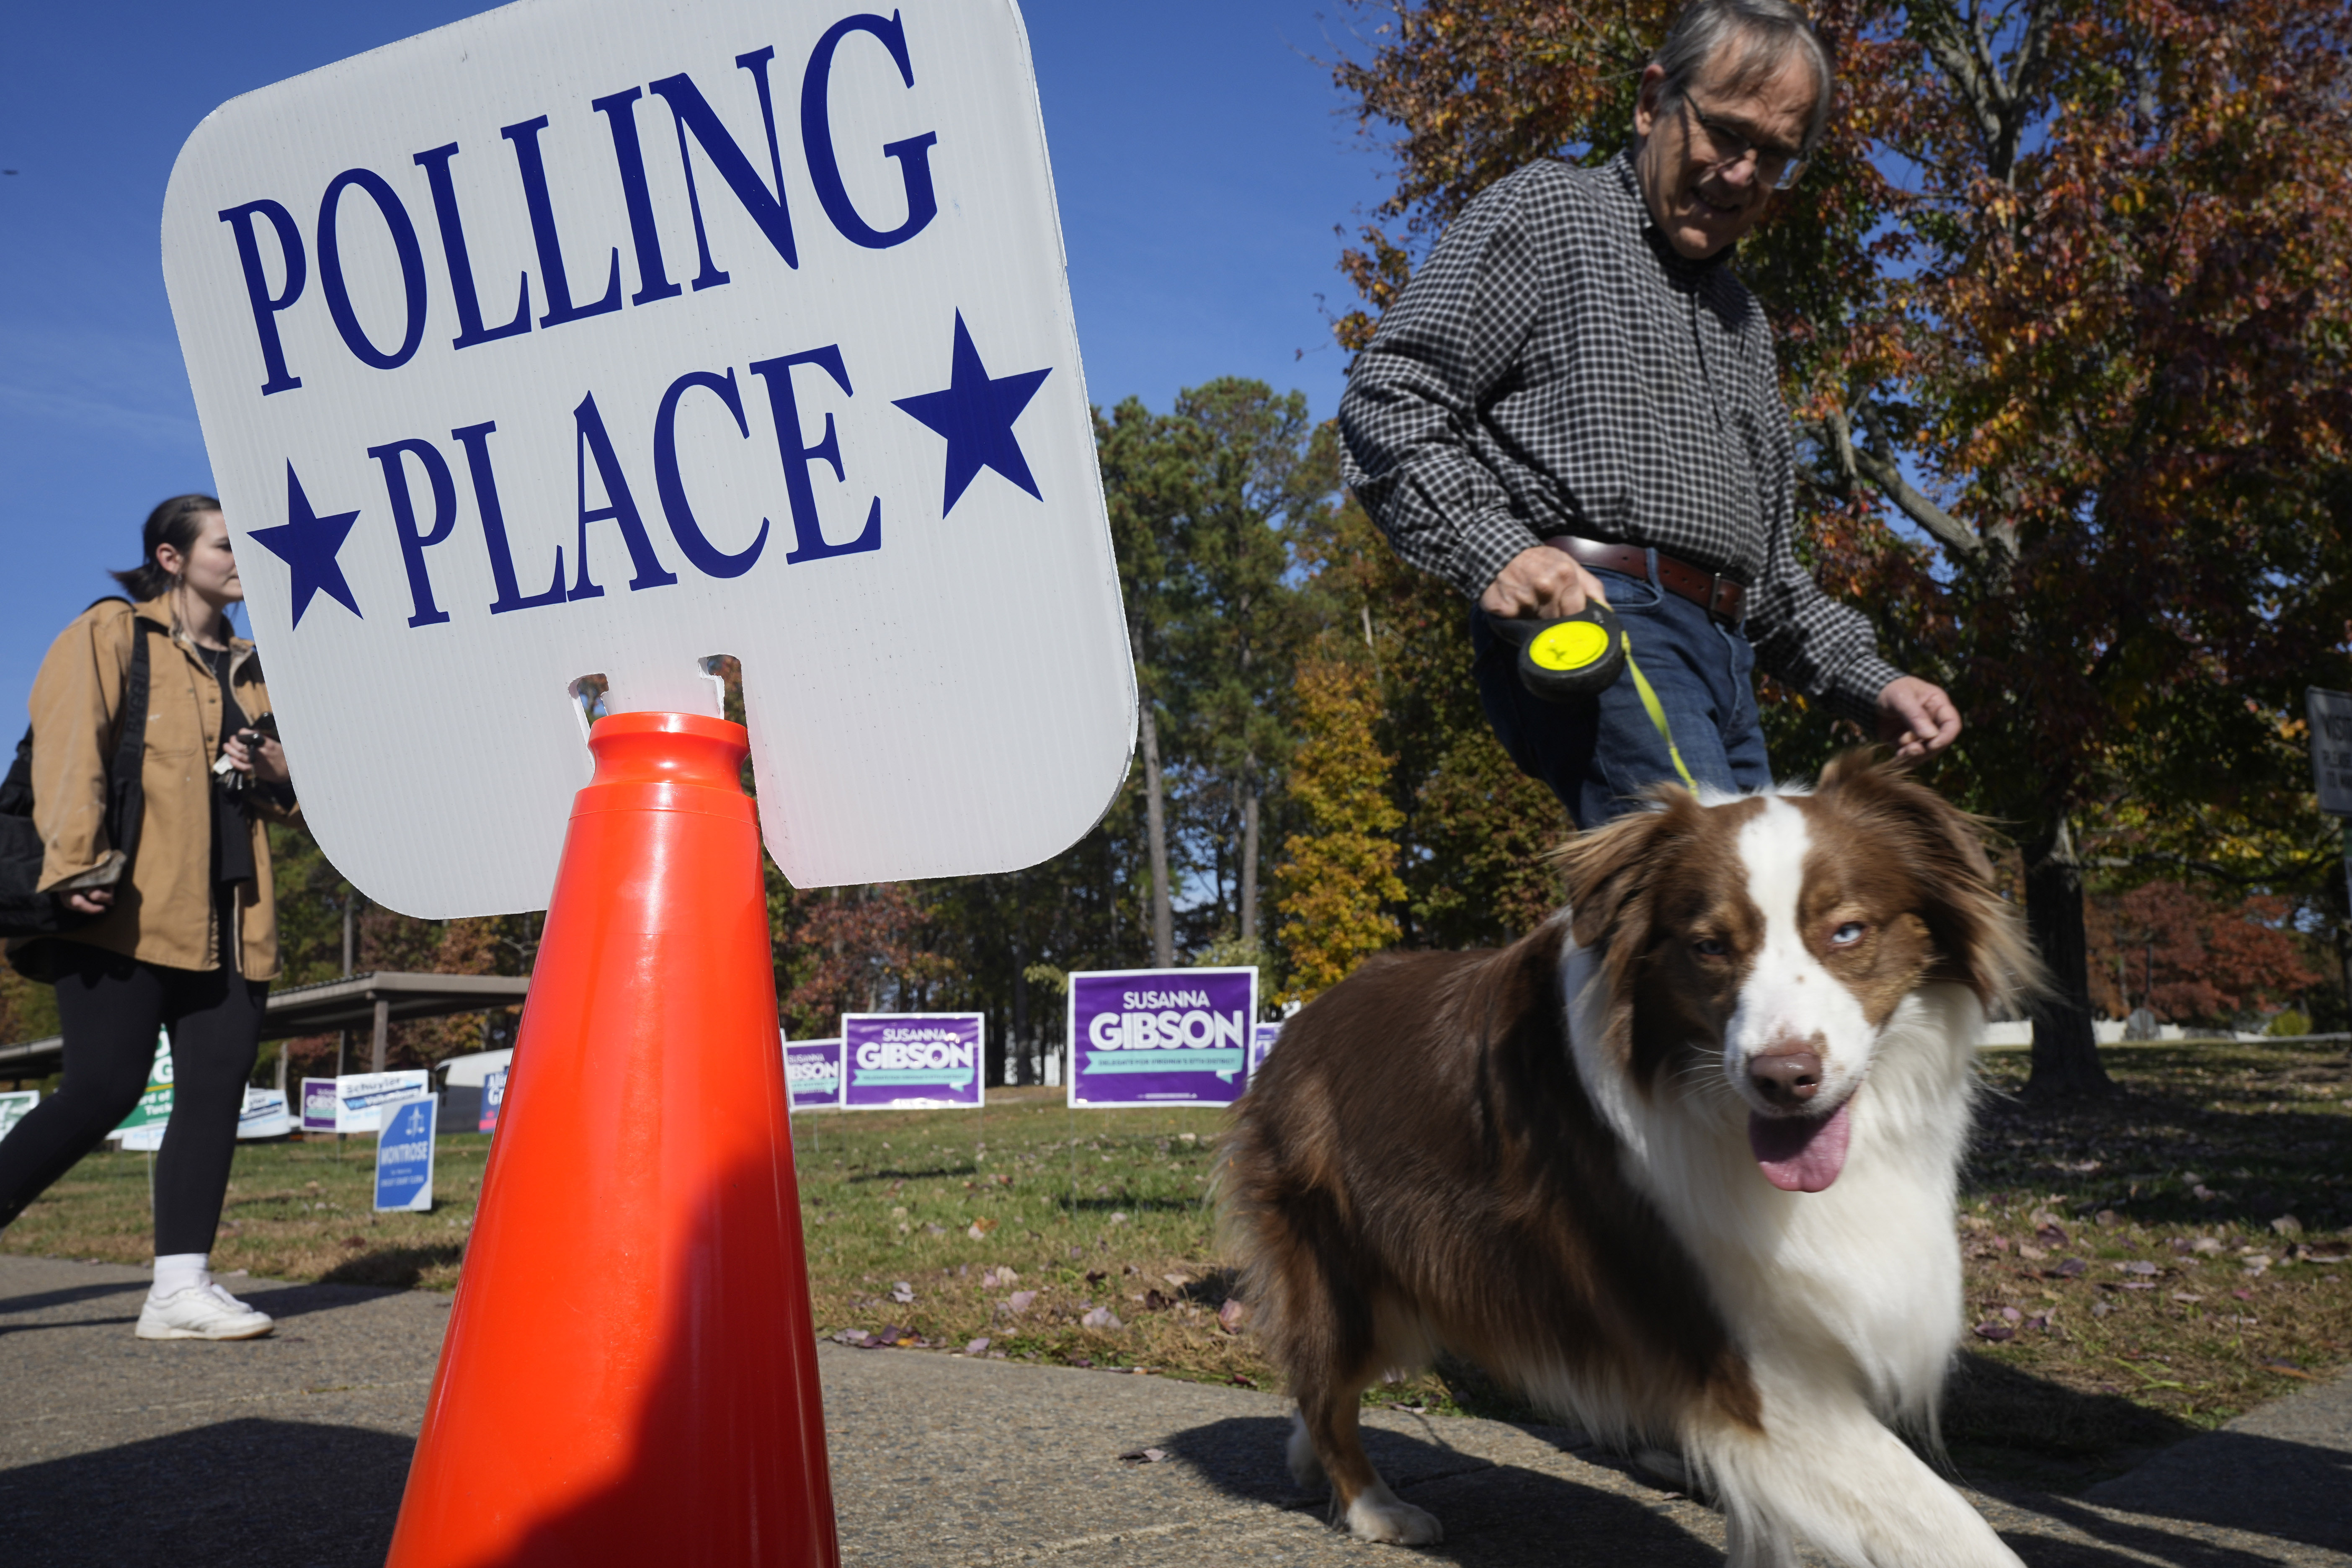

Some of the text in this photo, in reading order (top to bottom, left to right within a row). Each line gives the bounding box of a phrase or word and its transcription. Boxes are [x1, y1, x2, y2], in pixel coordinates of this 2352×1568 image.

[218, 8, 937, 396] POLLING
[368, 343, 881, 629] PLACE
[1123, 990, 1210, 1009] SUSANNA
[882, 1028, 947, 1042] SUSANNA
[1089, 1010, 1243, 1050] GIBSON
[856, 1042, 973, 1070] GIBSON
[346, 1078, 400, 1093] Schuyler
[381, 1140, 428, 1166] MONTROSE
